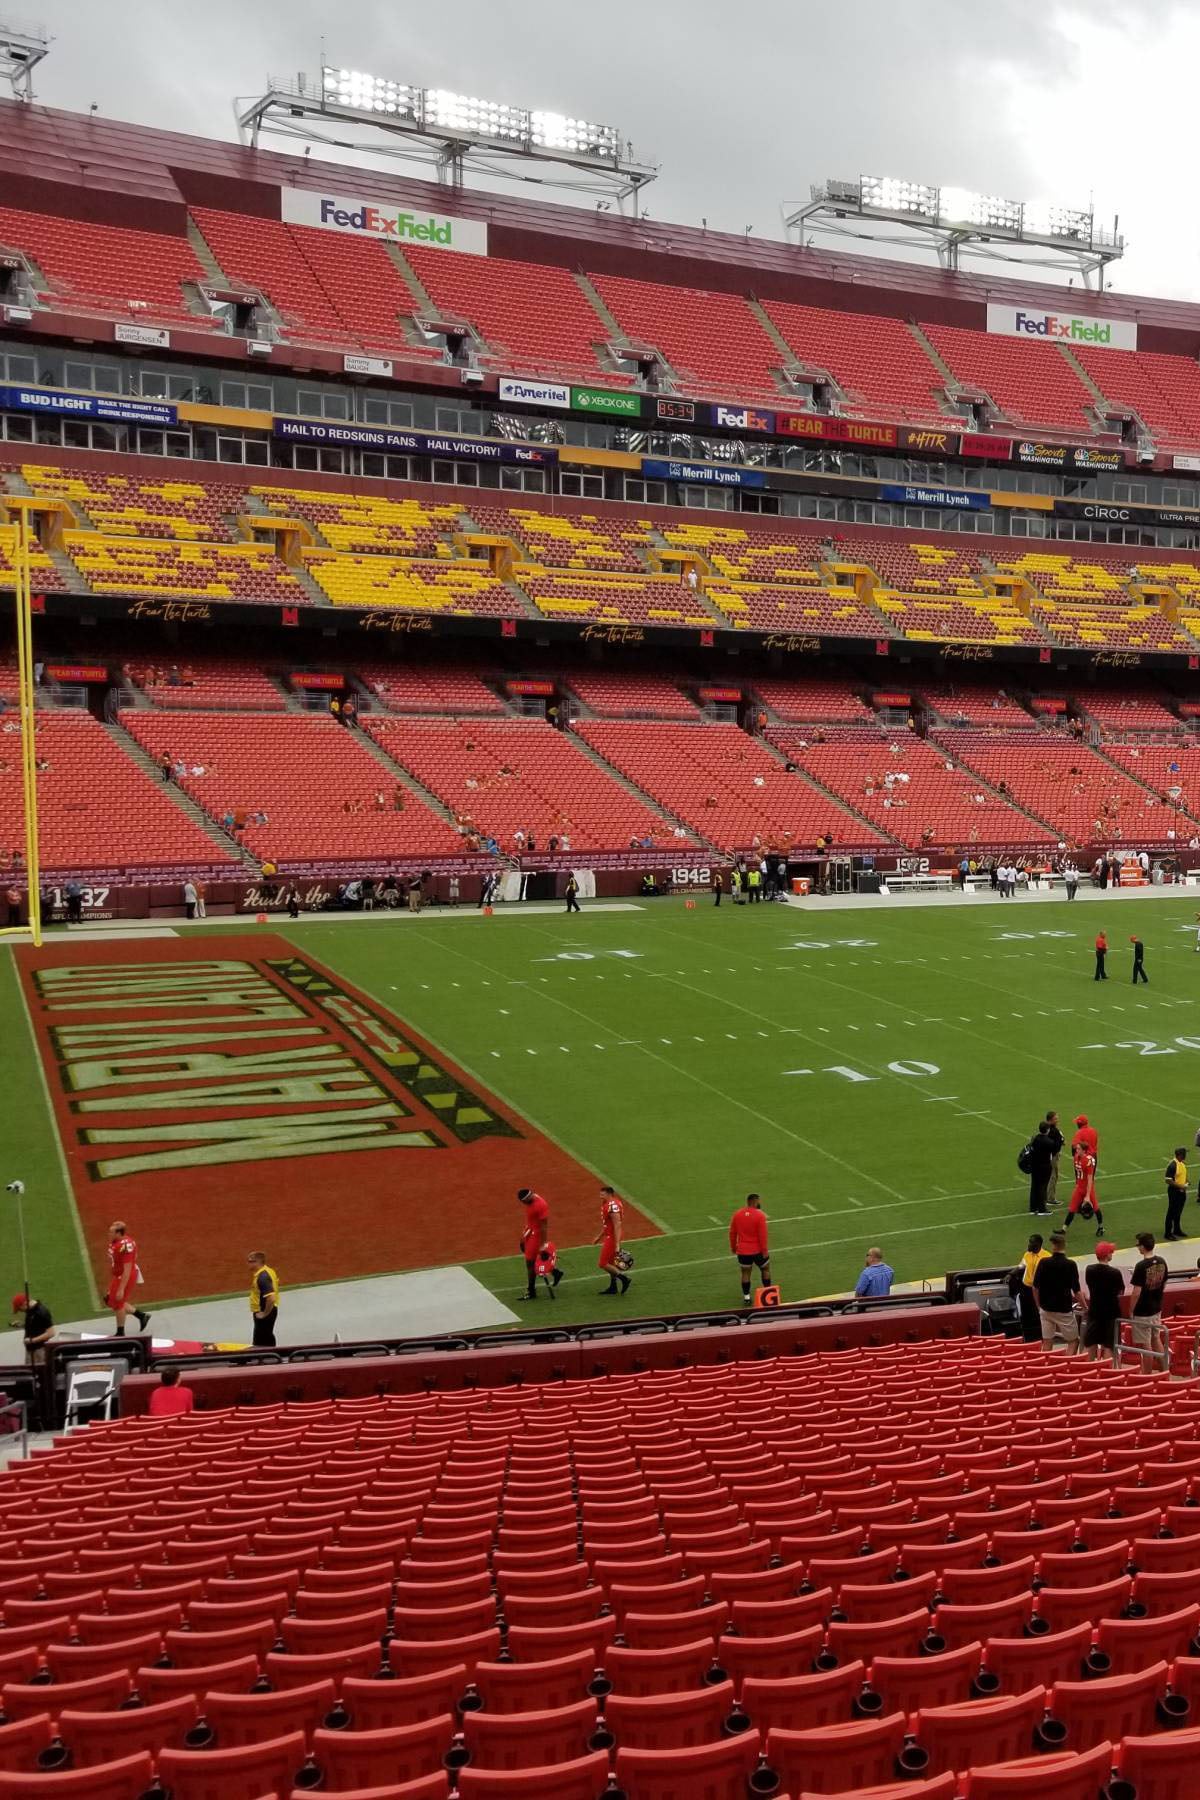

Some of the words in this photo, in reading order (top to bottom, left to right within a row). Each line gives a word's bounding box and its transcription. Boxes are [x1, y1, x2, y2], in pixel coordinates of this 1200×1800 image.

[320, 199, 452, 245] FedExField
[242, 294, 255, 304] 425
[1015, 312, 1111, 344] FedExField
[513, 384, 566, 402] Ameritel
[20, 393, 50, 406] BUD
[52, 396, 92, 411] LIGHT
[591, 396, 615, 408] XBOX
[615, 400, 635, 411] ONE
[717, 407, 767, 430] FedEx
[283, 423, 309, 436] HAIL
[310, 426, 326, 437] TO
[328, 428, 385, 446] REDSKINS
[386, 434, 419, 448] FANS.
[427, 439, 451, 452] HAIL
[452, 441, 500, 457] VICTORY!
[515, 448, 543, 461] FedEx
[1033, 444, 1067, 459] Sports
[1087, 450, 1121, 464] Sports
[1019, 455, 1064, 465] WASHINGTON
[1075, 460, 1119, 470] WASHINGTON
[682, 466, 713, 480] Merrill
[714, 470, 741, 483] Lynch
[917, 490, 944, 503] Merrill
[945, 493, 970, 505] Lynch
[1160, 513, 1183, 522] ULTRA
[896, 858, 930, 872] 192
[1016, 855, 1033, 868] the
[671, 868, 711, 884] 1942
[53, 887, 110, 908] 137
[304, 885, 331, 904] the
[555, 948, 646, 962] 10
[31, 959, 450, 1182] MARYLAND
[821, 1059, 942, 1084] 10
[760, 1287, 780, 1307] G
